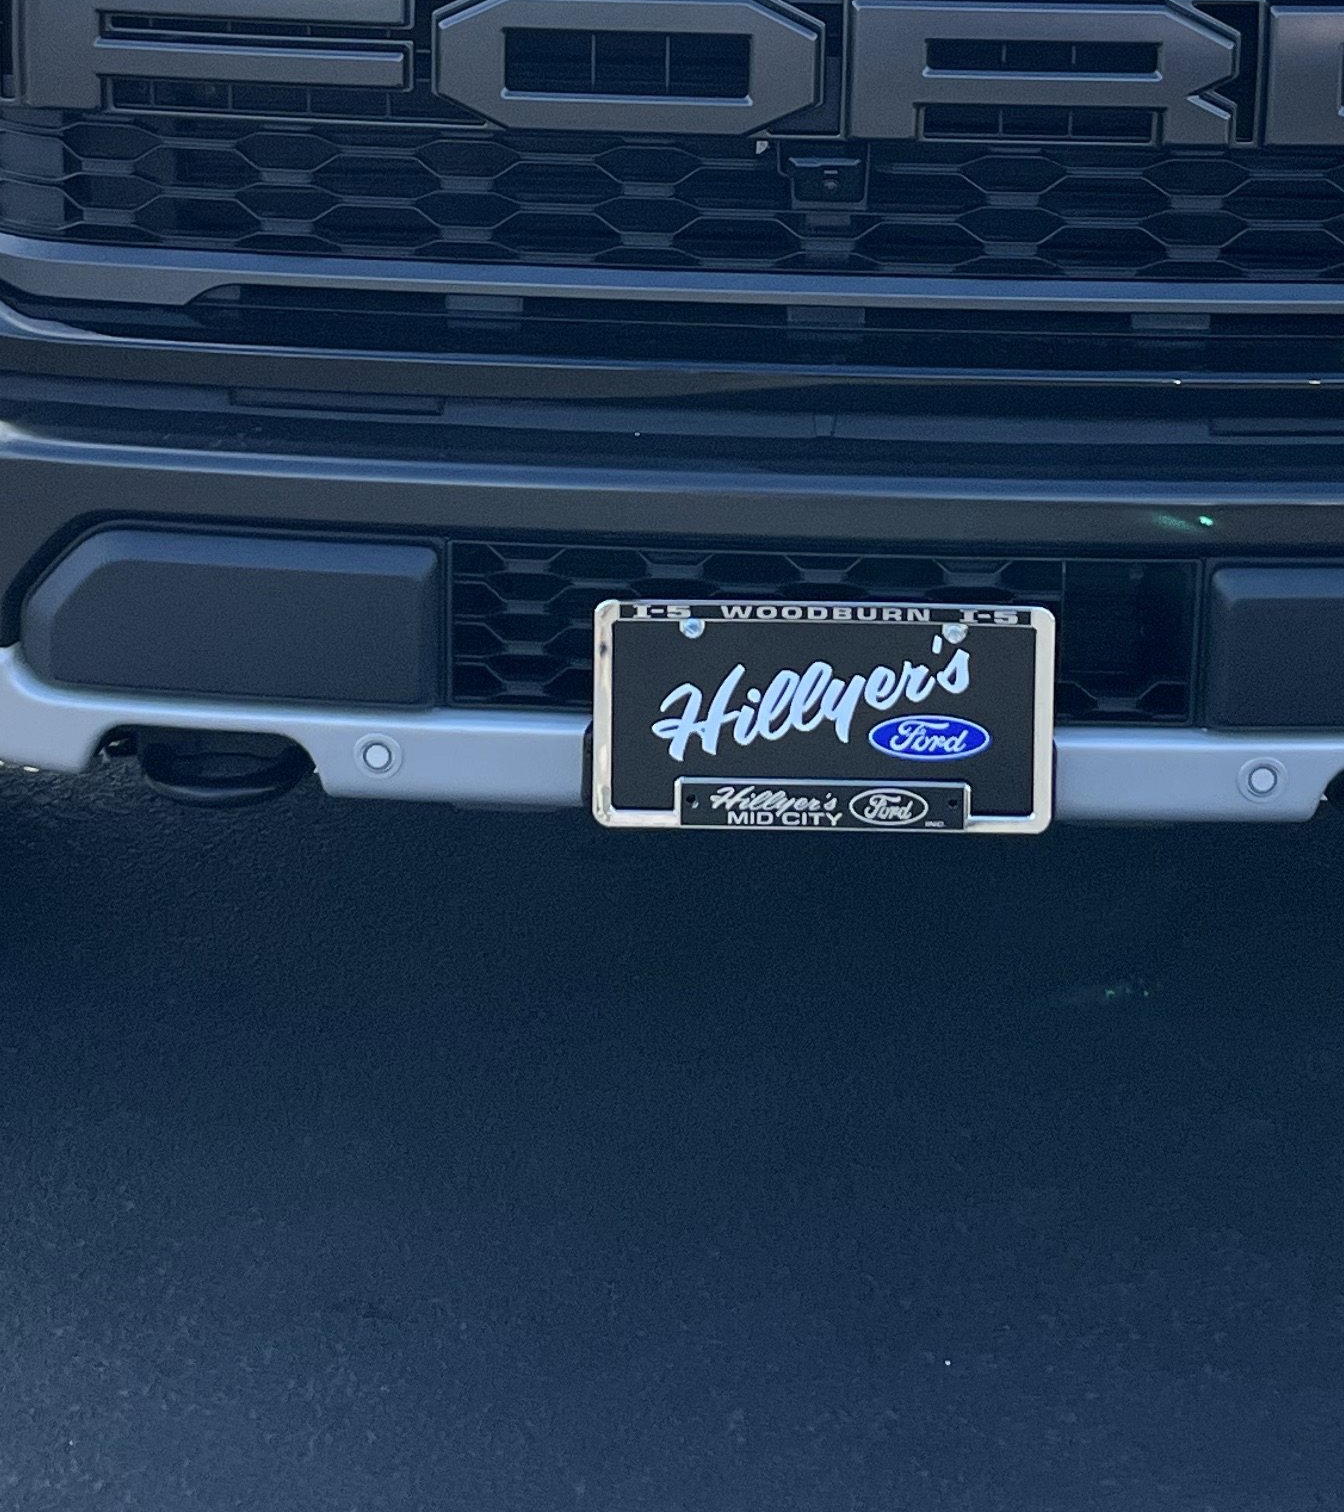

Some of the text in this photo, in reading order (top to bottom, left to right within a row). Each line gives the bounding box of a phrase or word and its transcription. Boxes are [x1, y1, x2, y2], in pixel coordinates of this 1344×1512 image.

[632, 604, 1019, 625] I-5 WOODBURN I-5
[651, 634, 971, 763] Hillyer's
[887, 719, 970, 754] Ford
[709, 785, 839, 818] Hillyer's
[862, 792, 915, 821] Ford
[726, 810, 844, 827] MID CITY
